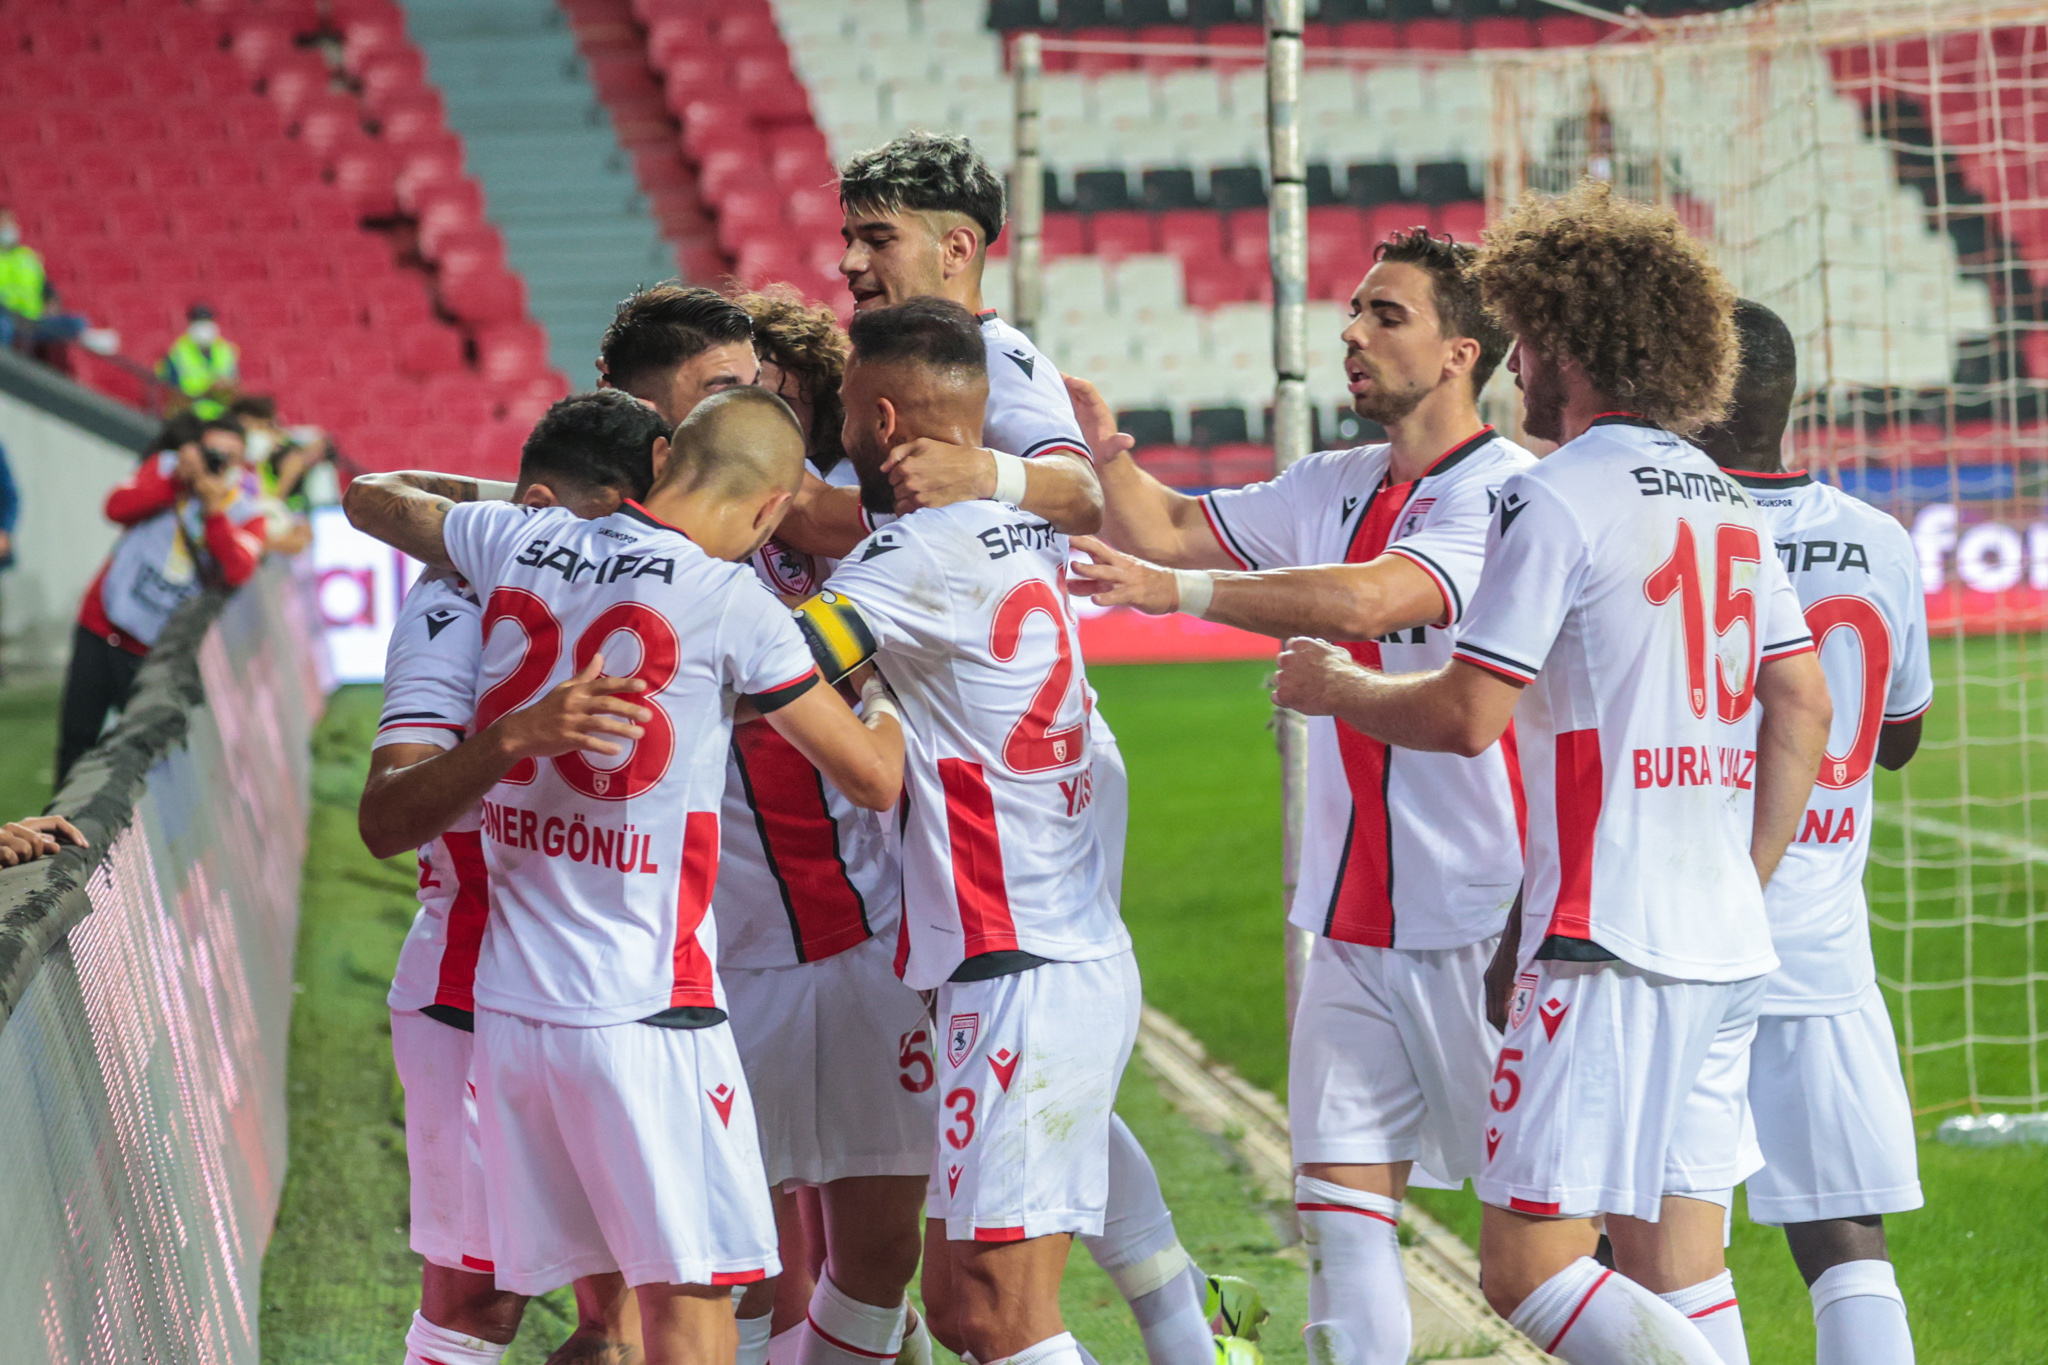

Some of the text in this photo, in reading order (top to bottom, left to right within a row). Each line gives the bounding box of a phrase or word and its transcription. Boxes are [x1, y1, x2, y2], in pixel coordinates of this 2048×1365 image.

[1629, 466, 1749, 509] SAMPA
[1643, 517, 1762, 725] 15
[475, 586, 680, 801] 28
[1490, 1047, 1524, 1113] 5
[944, 1087, 976, 1150] 3
